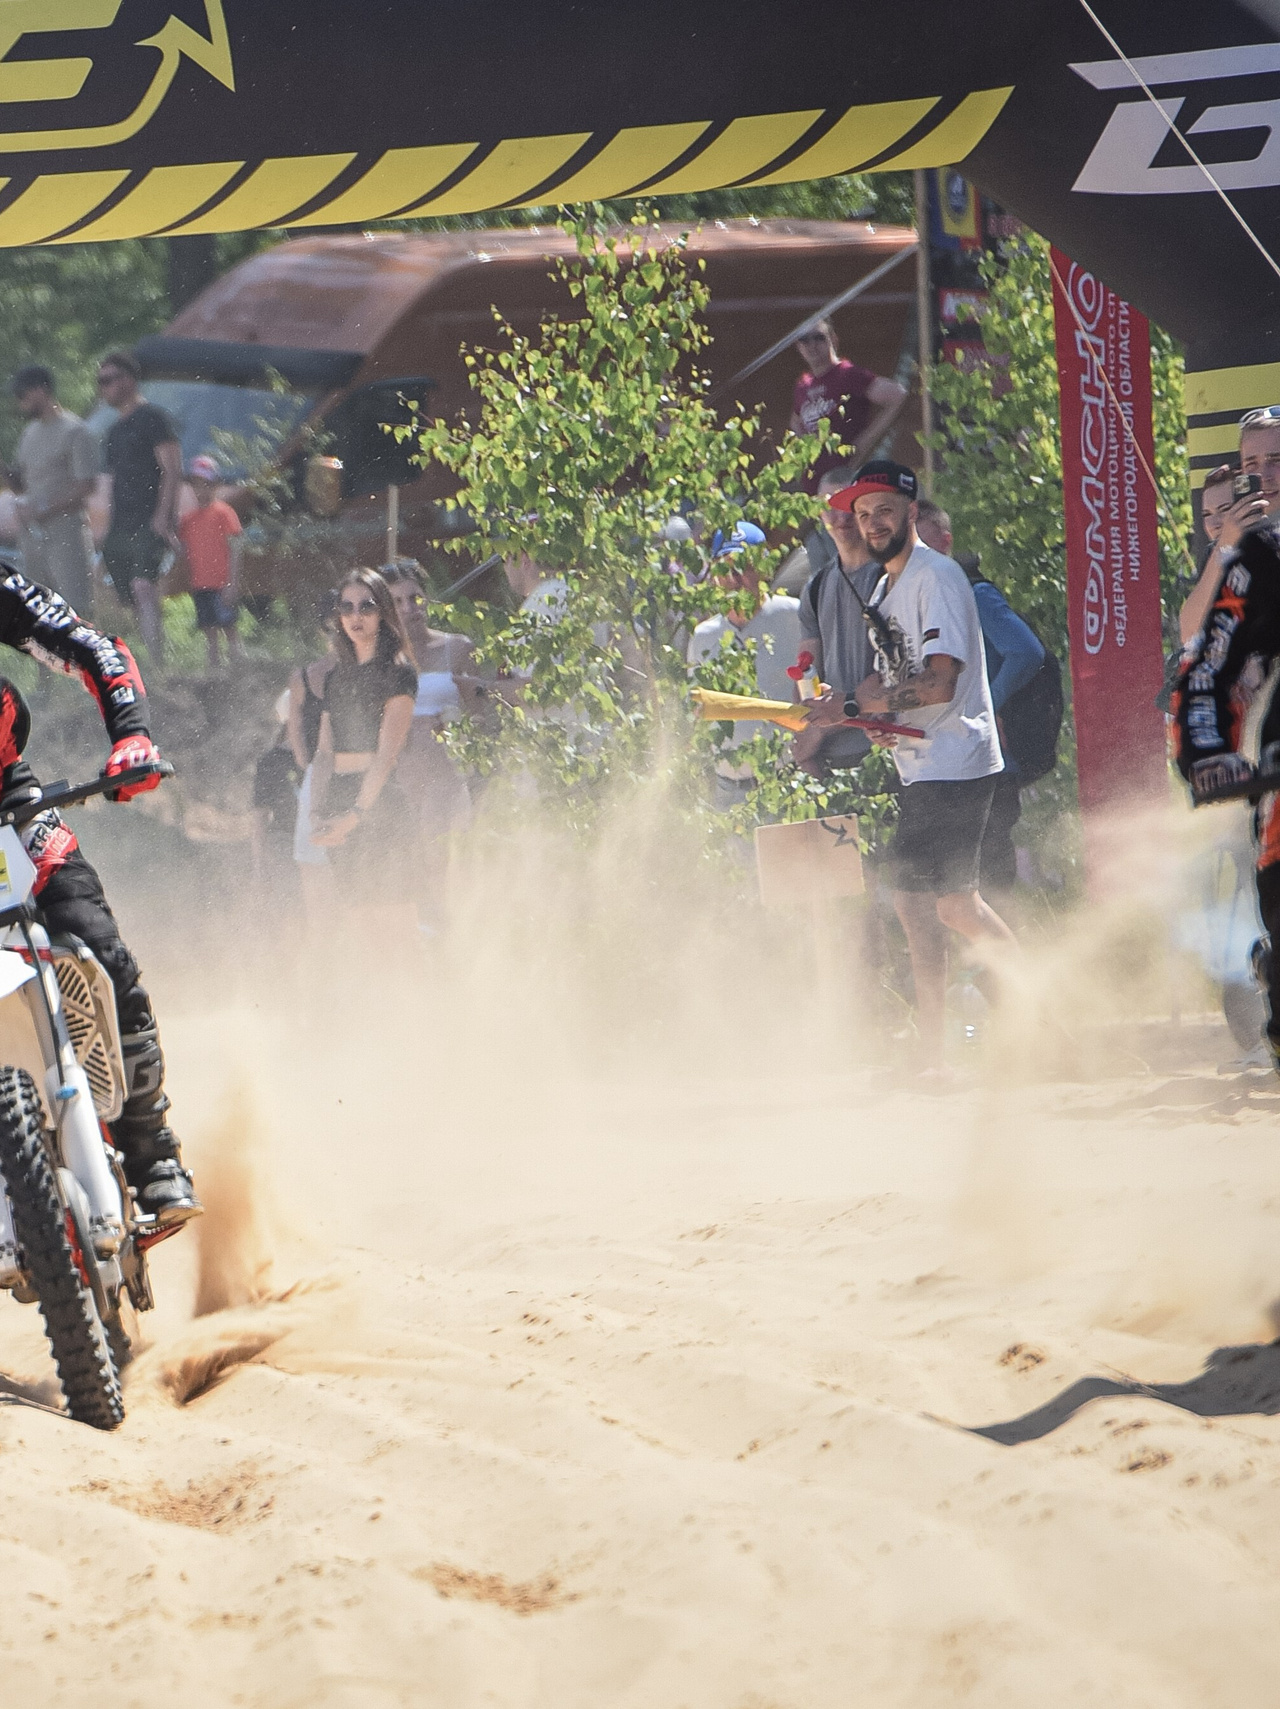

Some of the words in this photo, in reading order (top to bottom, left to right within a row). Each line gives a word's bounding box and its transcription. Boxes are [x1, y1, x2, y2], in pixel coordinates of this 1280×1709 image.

[1118, 300, 1133, 396] ОБЛАСТИ
[1067, 261, 1108, 654] ФМСНО
[1120, 401, 1141, 581] НИЖЕГОРОДСКОЙ
[1109, 526, 1128, 648] ФЕДЕРАЦИЯ
